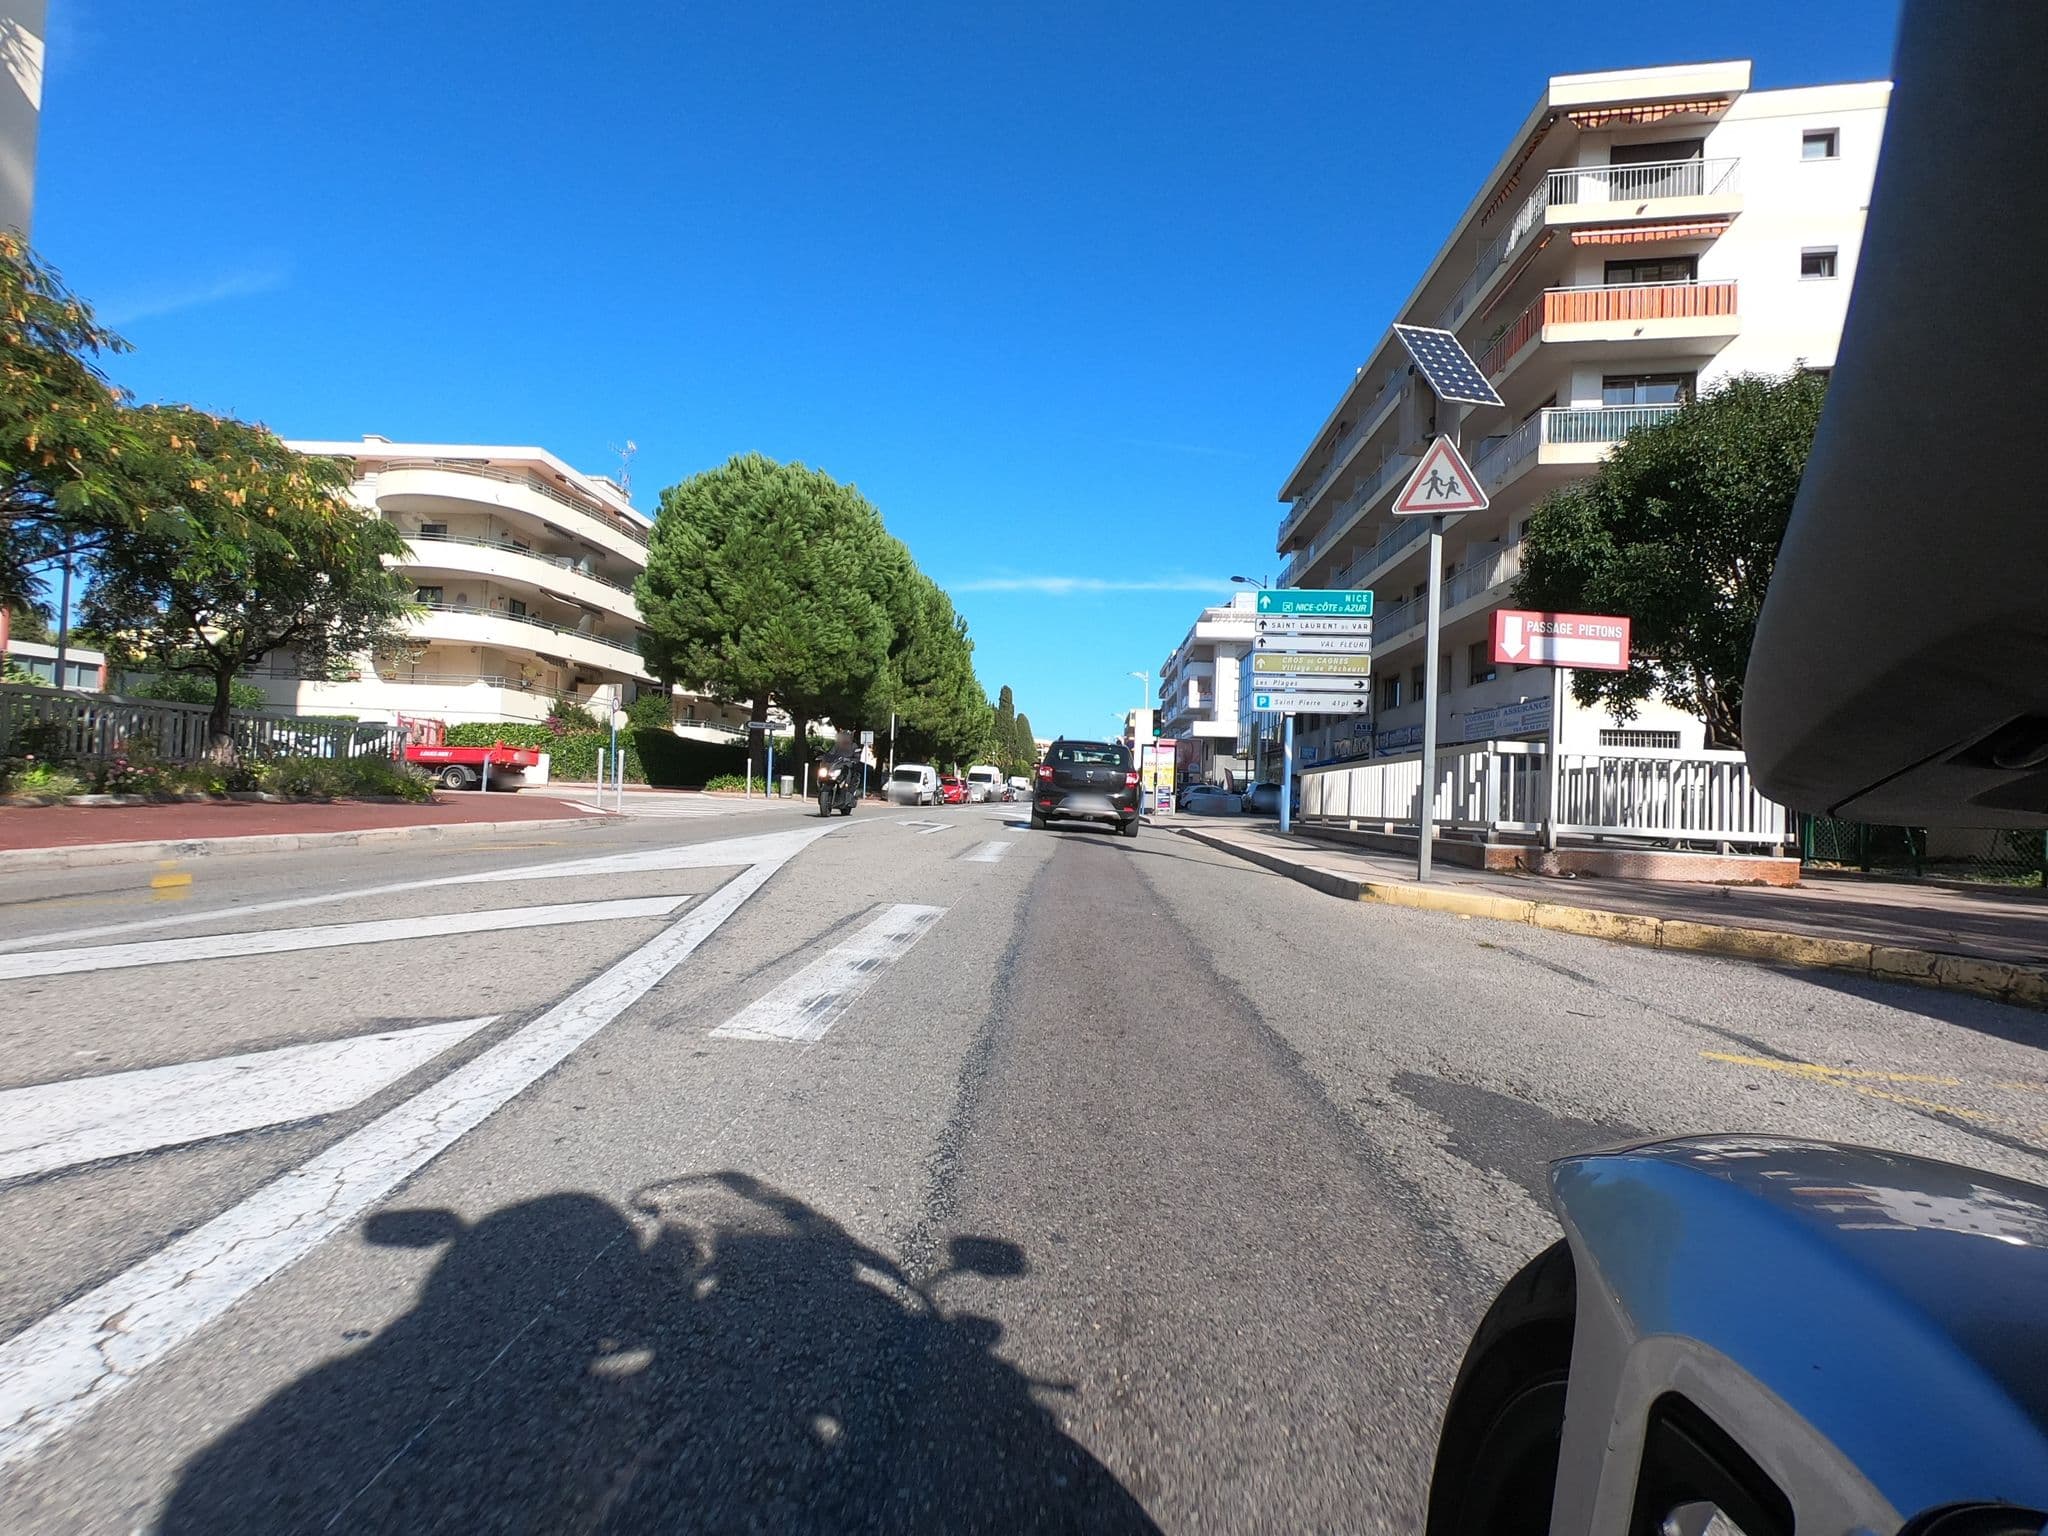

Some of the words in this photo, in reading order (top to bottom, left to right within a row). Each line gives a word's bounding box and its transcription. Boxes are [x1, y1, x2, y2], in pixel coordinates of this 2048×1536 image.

[1345, 594, 1368, 603] NICE
[1296, 601, 1338, 612] NICE-CÔTE
[1526, 620, 1573, 635] PASSAGE
[1578, 623, 1623, 638] PIETONS
[1316, 657, 1350, 665] CAGNES
